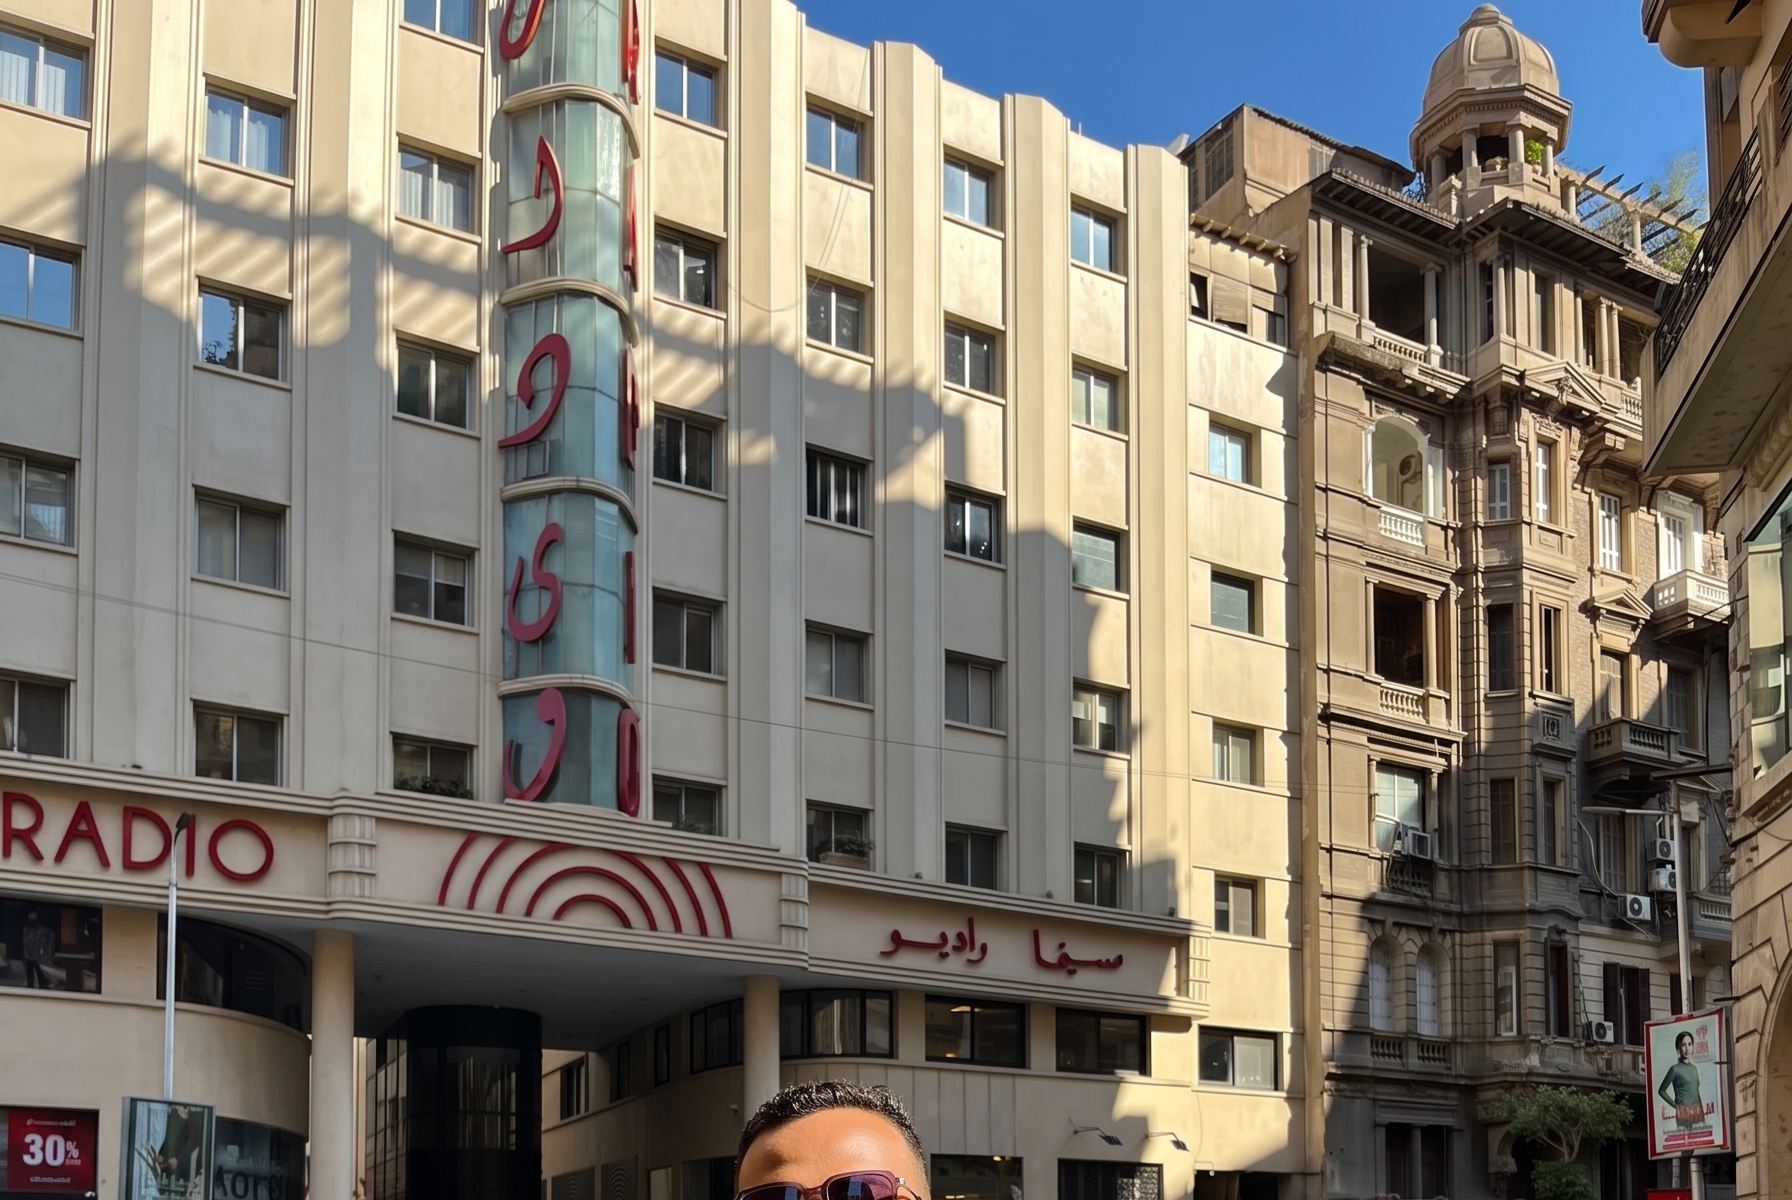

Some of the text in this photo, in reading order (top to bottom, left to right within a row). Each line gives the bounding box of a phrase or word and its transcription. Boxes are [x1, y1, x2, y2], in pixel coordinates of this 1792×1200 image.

[3, 791, 274, 881] RADIO
[880, 916, 987, 963] راديو
[22, 1133, 79, 1167] 30%
